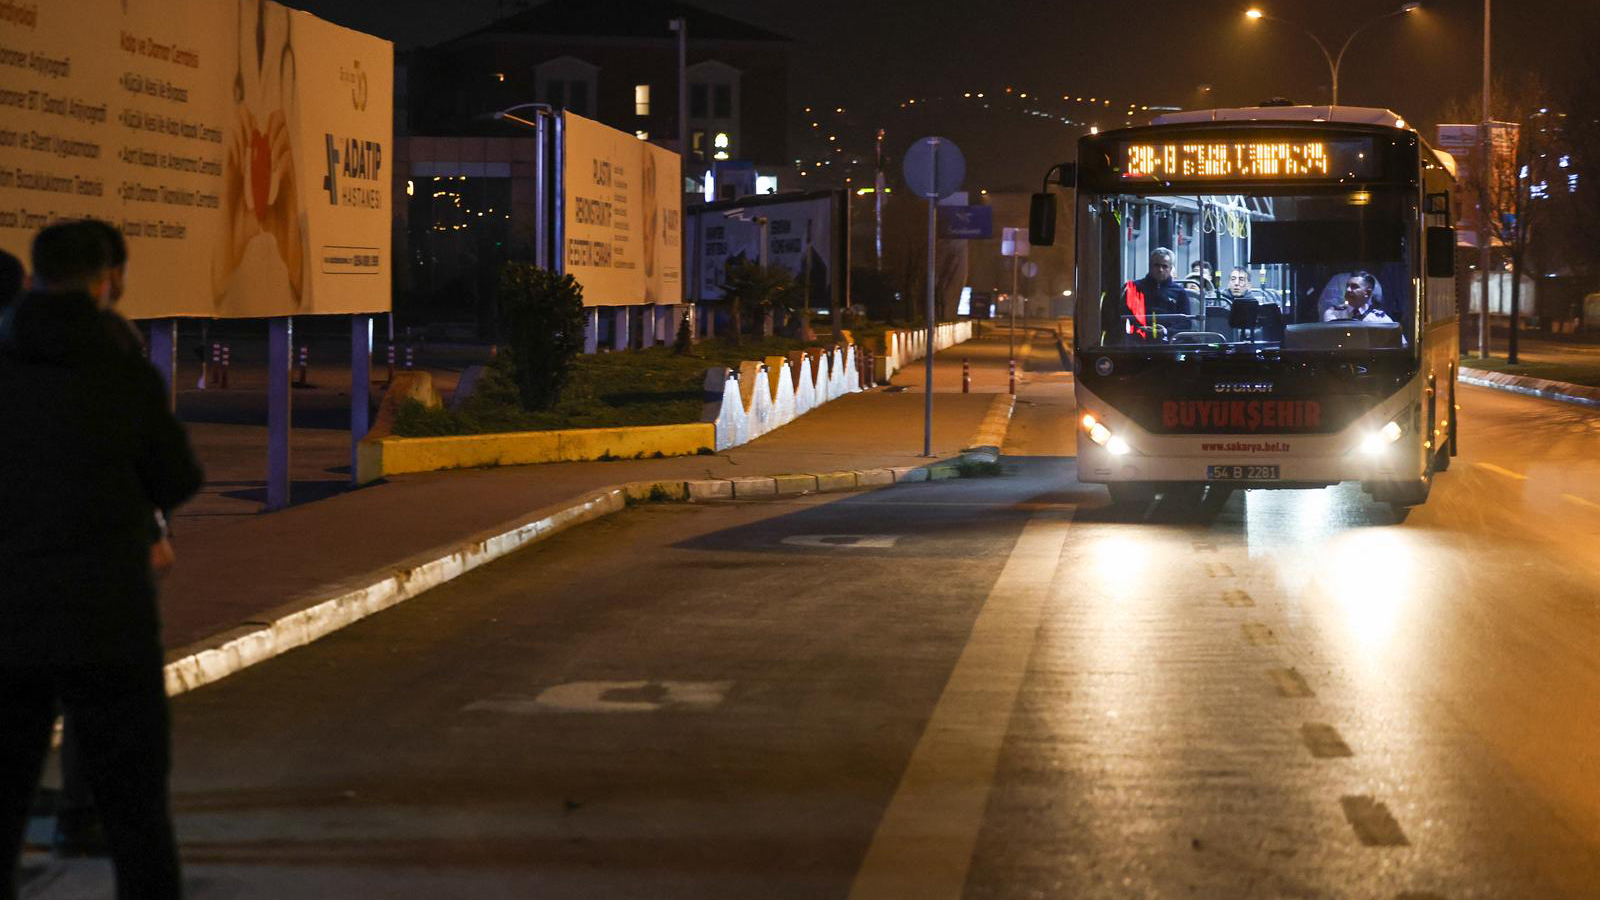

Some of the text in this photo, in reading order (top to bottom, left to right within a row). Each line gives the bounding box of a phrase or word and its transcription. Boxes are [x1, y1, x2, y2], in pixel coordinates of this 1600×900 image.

[343, 137, 383, 180] ADATIP
[1162, 400, 1321, 430] BÜYÜKŞEHİR
[1201, 441, 1290, 453] www.sakarya.bel.tr
[1214, 466, 1276, 478] 54 B 2281
